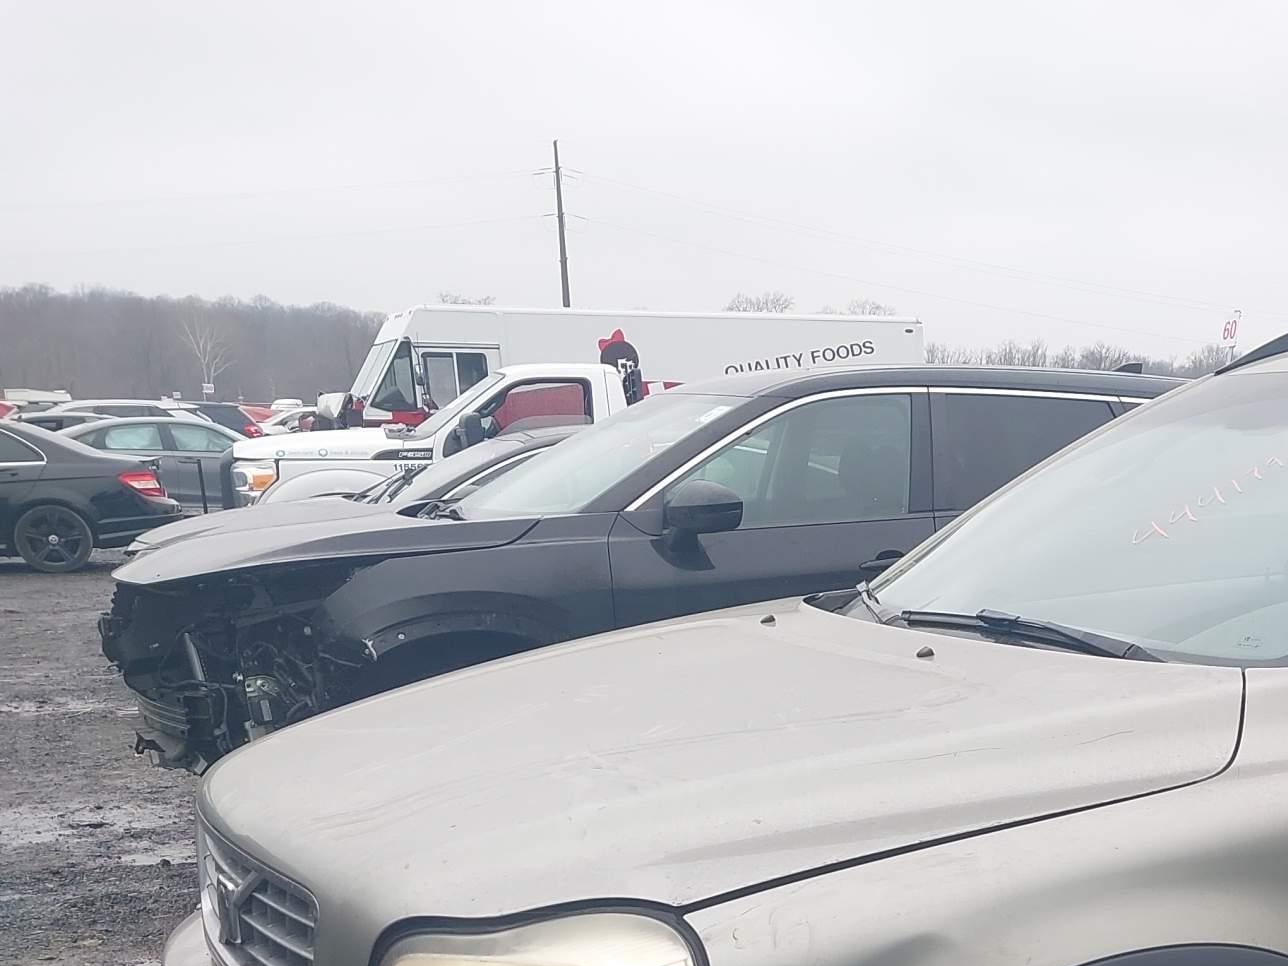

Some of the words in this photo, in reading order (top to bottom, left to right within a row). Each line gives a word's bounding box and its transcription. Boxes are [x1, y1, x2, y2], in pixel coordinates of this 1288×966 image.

[1223, 319, 1237, 340] 60
[725, 352, 803, 375] QUALITY
[811, 340, 875, 364] FOODS
